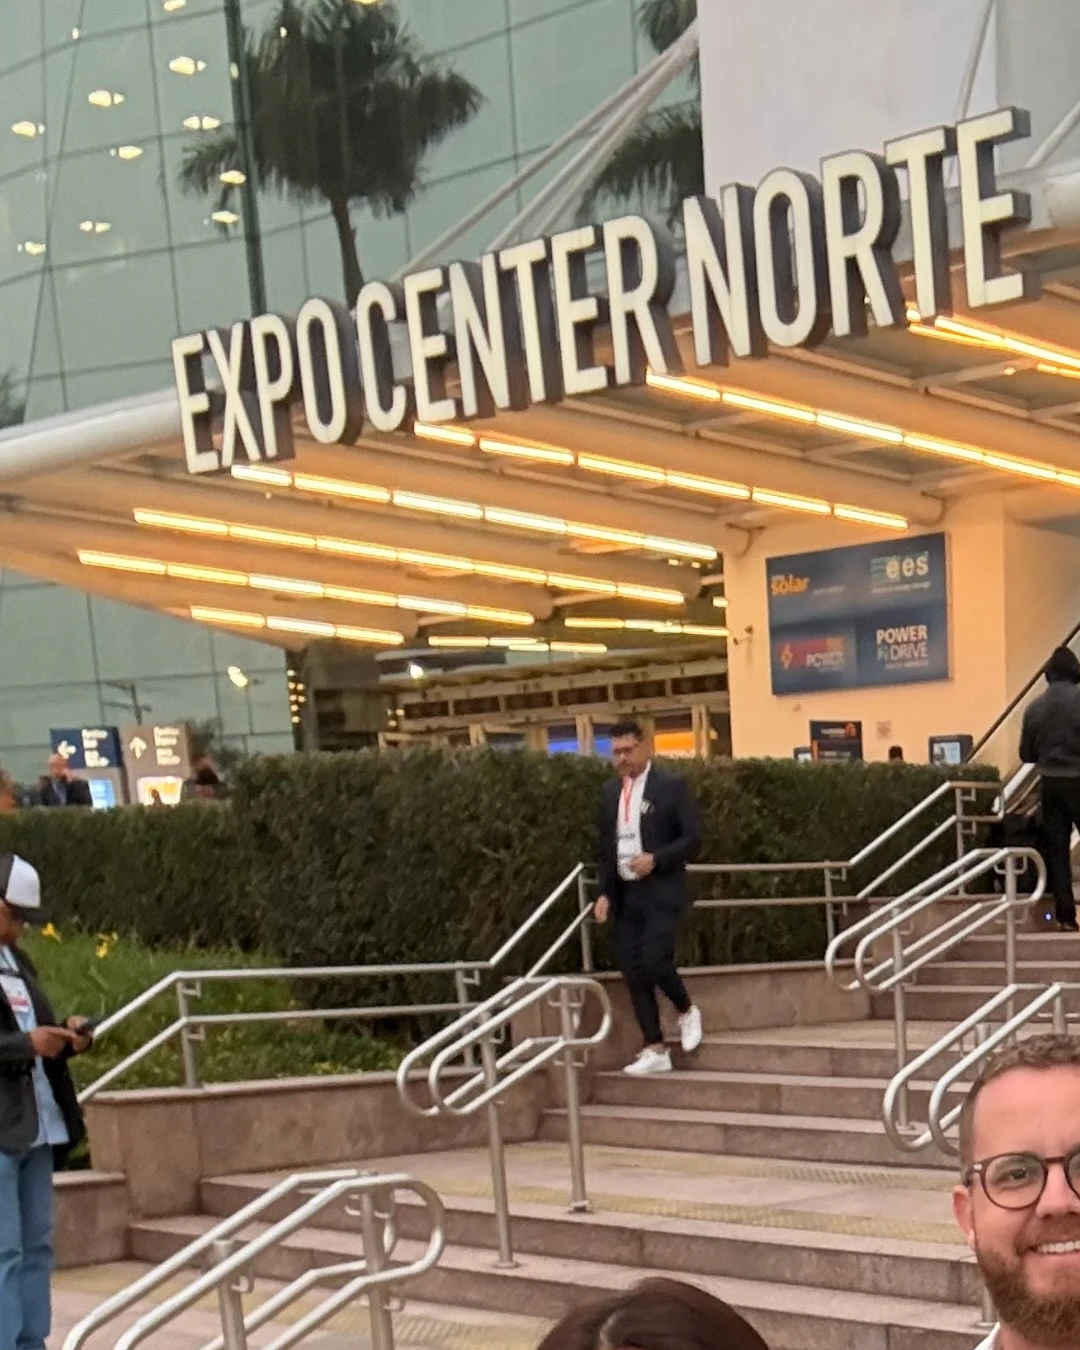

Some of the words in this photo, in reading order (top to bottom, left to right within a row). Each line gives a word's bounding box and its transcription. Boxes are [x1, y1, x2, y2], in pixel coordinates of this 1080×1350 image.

[171, 297, 358, 473] EXPO
[355, 214, 682, 433] CENTER
[682, 107, 1030, 366] NORTE
[876, 624, 929, 645] POWER
